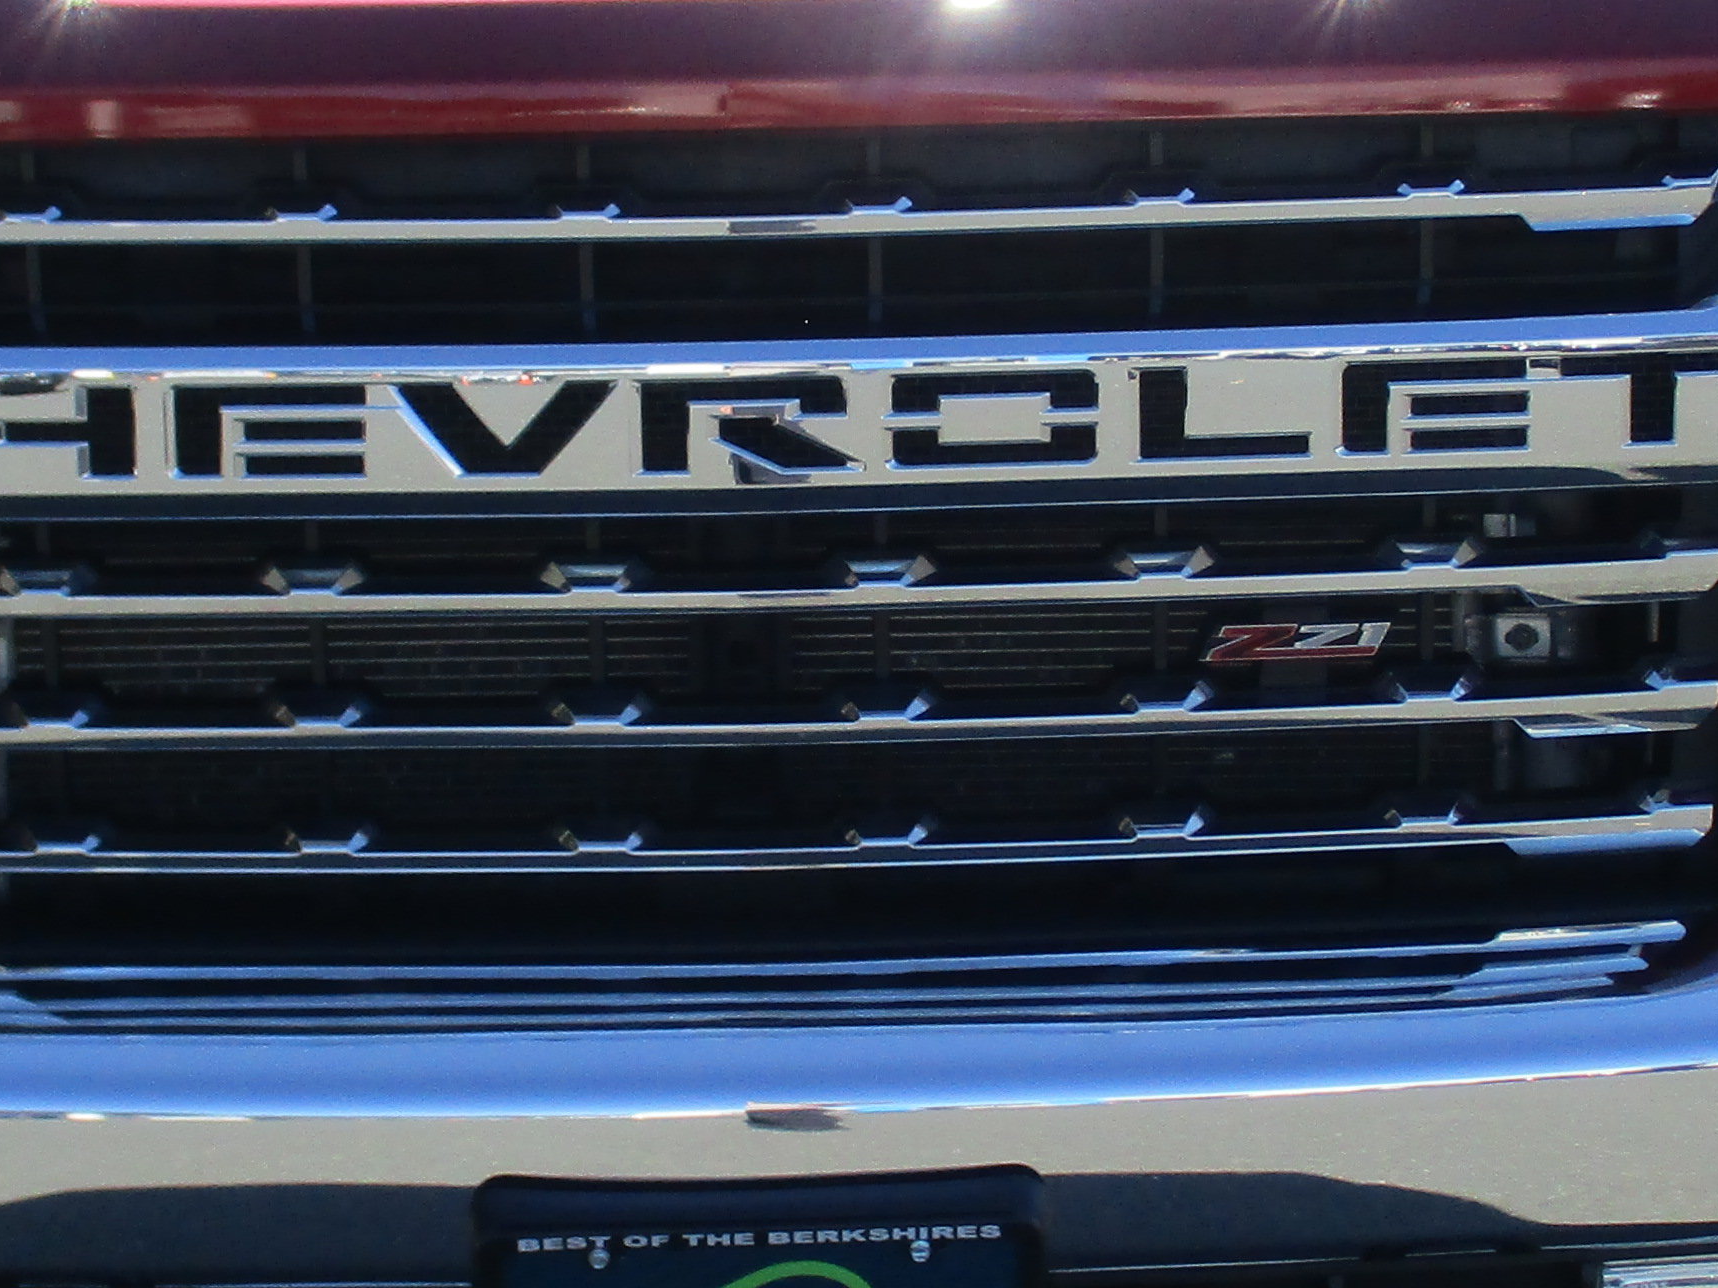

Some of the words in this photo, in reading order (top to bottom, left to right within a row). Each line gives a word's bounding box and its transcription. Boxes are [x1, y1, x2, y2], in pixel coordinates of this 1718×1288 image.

[1202, 621, 1392, 662] Z71
[517, 1235, 611, 1252] BEST
[623, 1233, 670, 1248] OF
[682, 1231, 755, 1247] THE
[767, 1225, 1001, 1245] BERKSHIRES
